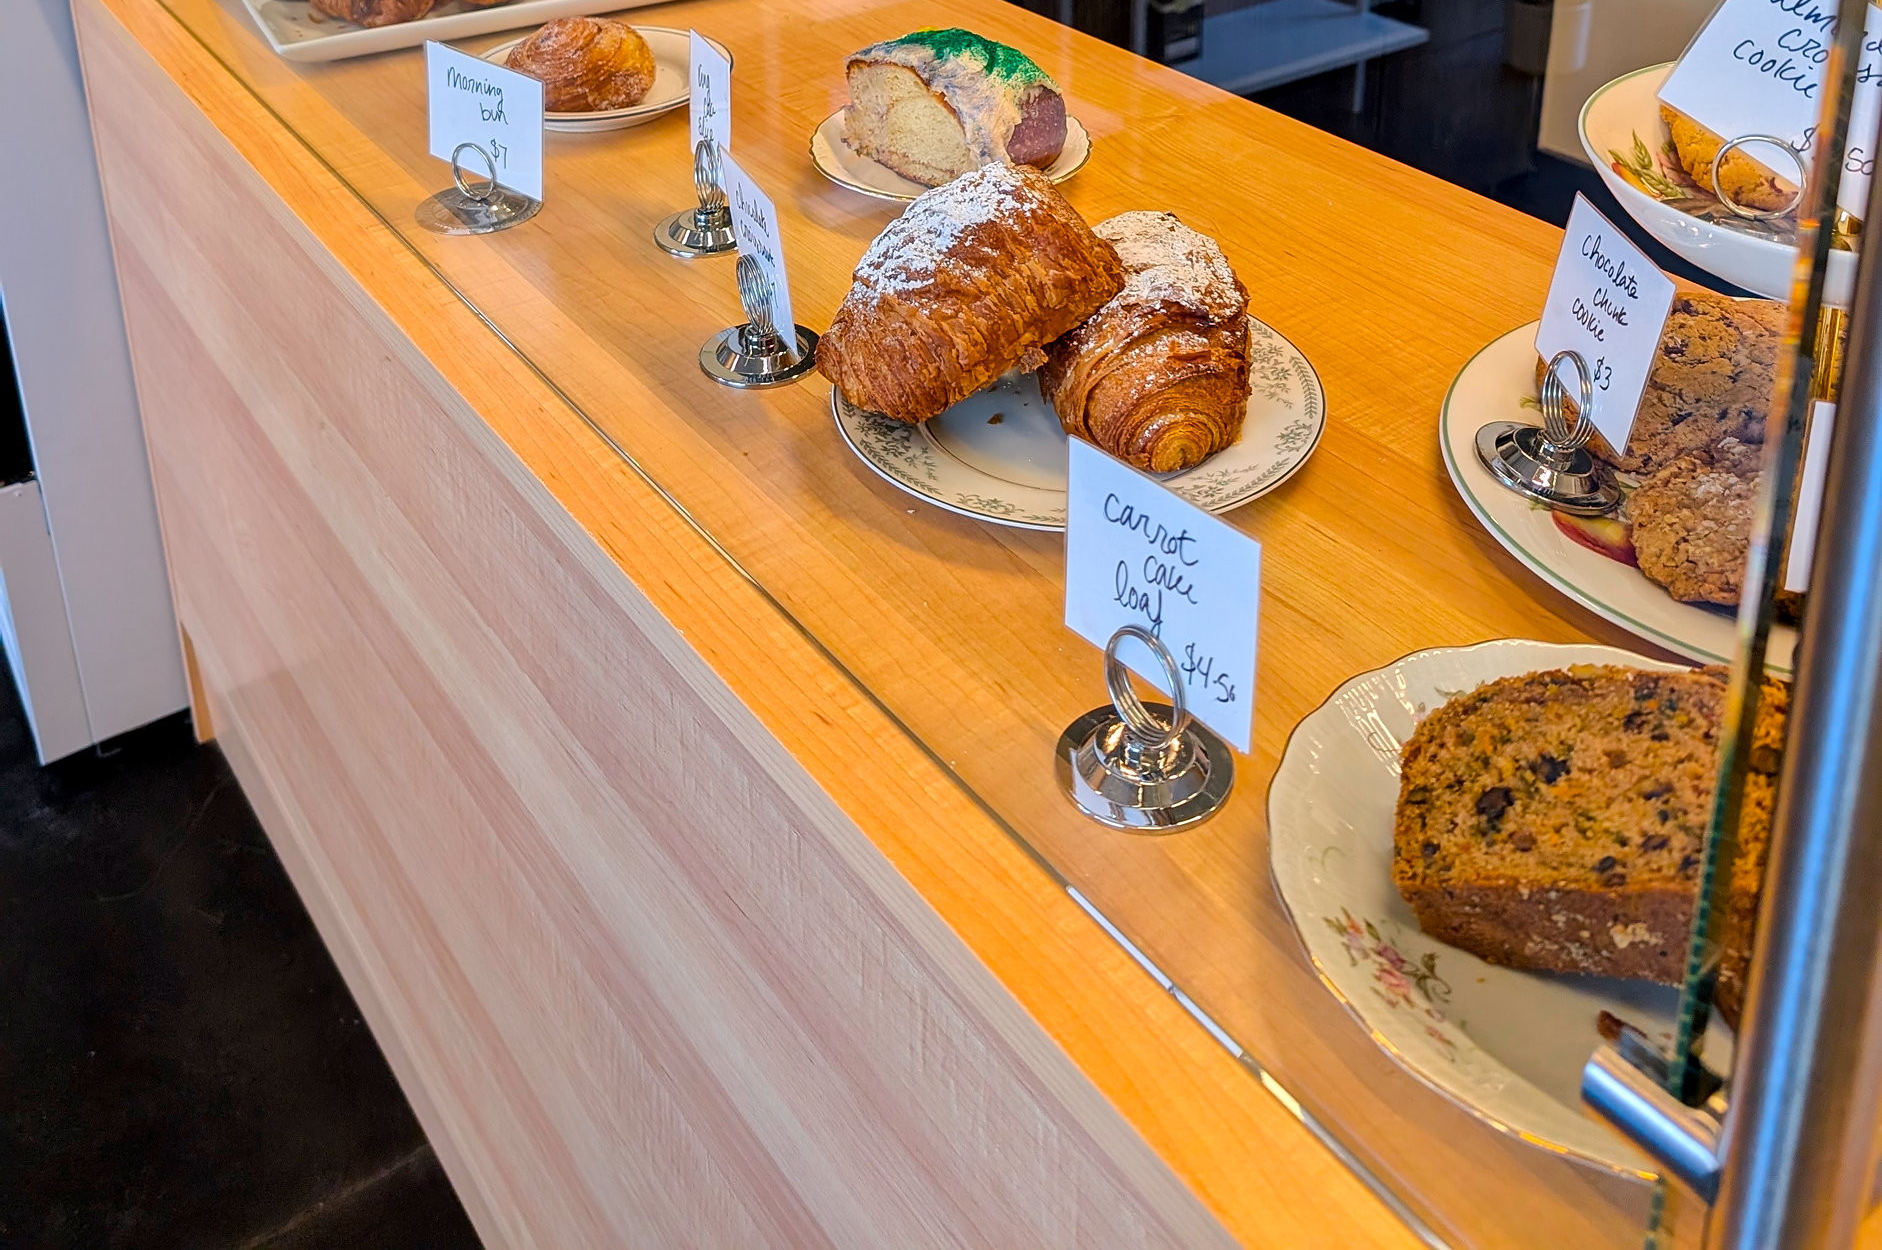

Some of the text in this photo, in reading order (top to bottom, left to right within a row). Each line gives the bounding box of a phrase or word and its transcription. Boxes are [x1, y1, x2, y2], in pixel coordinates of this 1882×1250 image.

[1733, 39, 1818, 99] cookie
[479, 102, 508, 125] bun
[490, 138, 508, 169] $7
[1582, 234, 1638, 299] chocolate
[1572, 297, 1604, 342] cookie
[1593, 287, 1628, 326] chunk
[1593, 356, 1612, 391] $3
[1103, 493, 1199, 566] carrot
[1114, 560, 1162, 638] loaf
